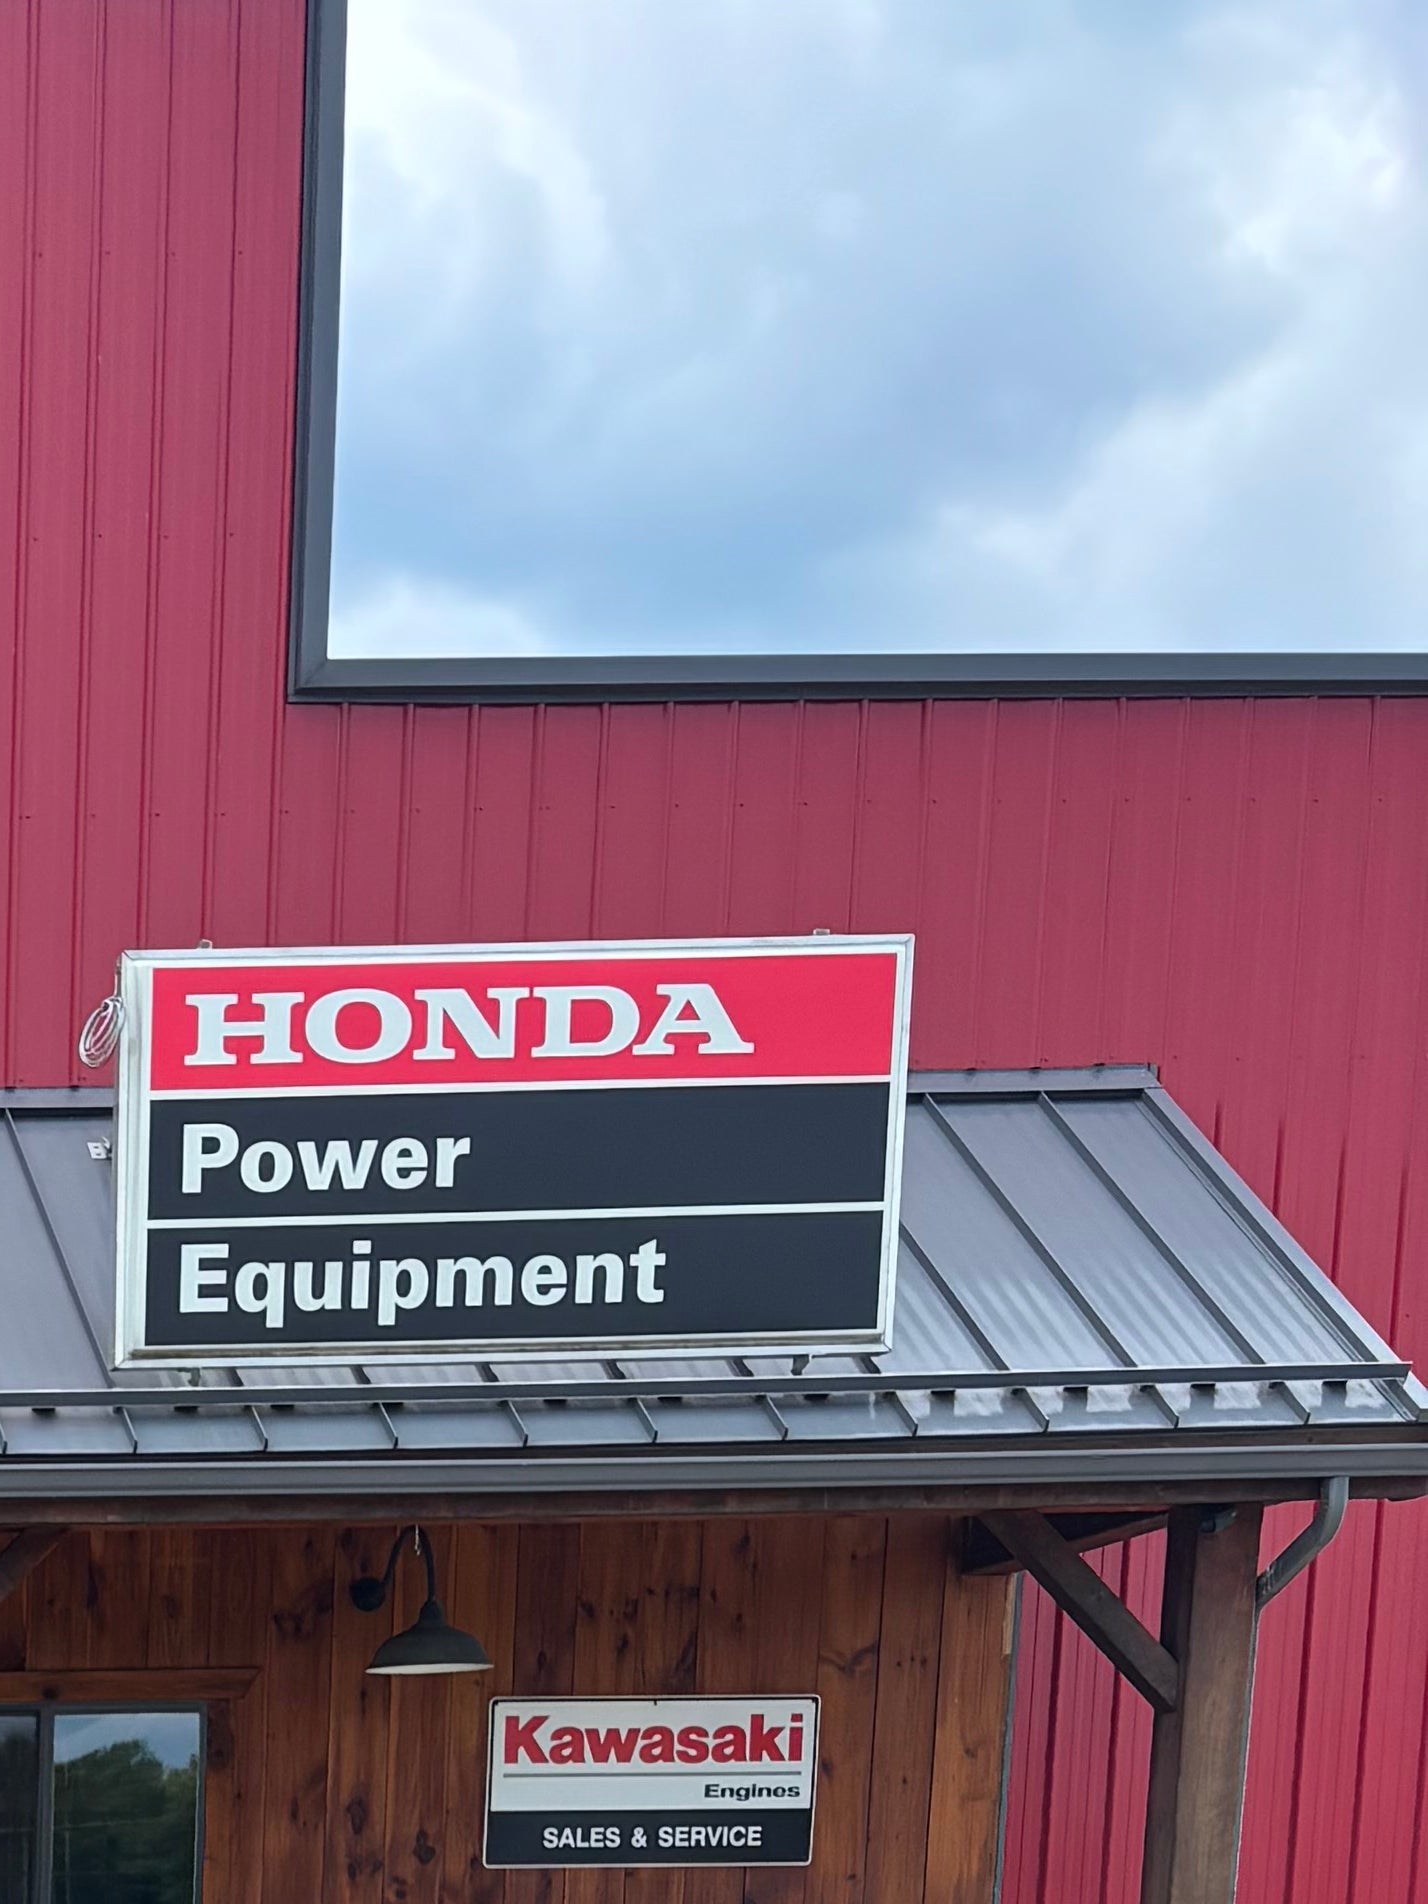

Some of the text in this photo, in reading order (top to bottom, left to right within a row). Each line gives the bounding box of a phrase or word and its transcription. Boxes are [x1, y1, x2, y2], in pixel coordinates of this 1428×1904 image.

[183, 983, 755, 1067] HONDA
[181, 1123, 471, 1194] Power
[179, 1239, 666, 1329] Equipment
[503, 1714, 803, 1764] Kawasaki
[704, 1783, 801, 1802] Engines
[542, 1825, 762, 1849] SALES & SERVICE
